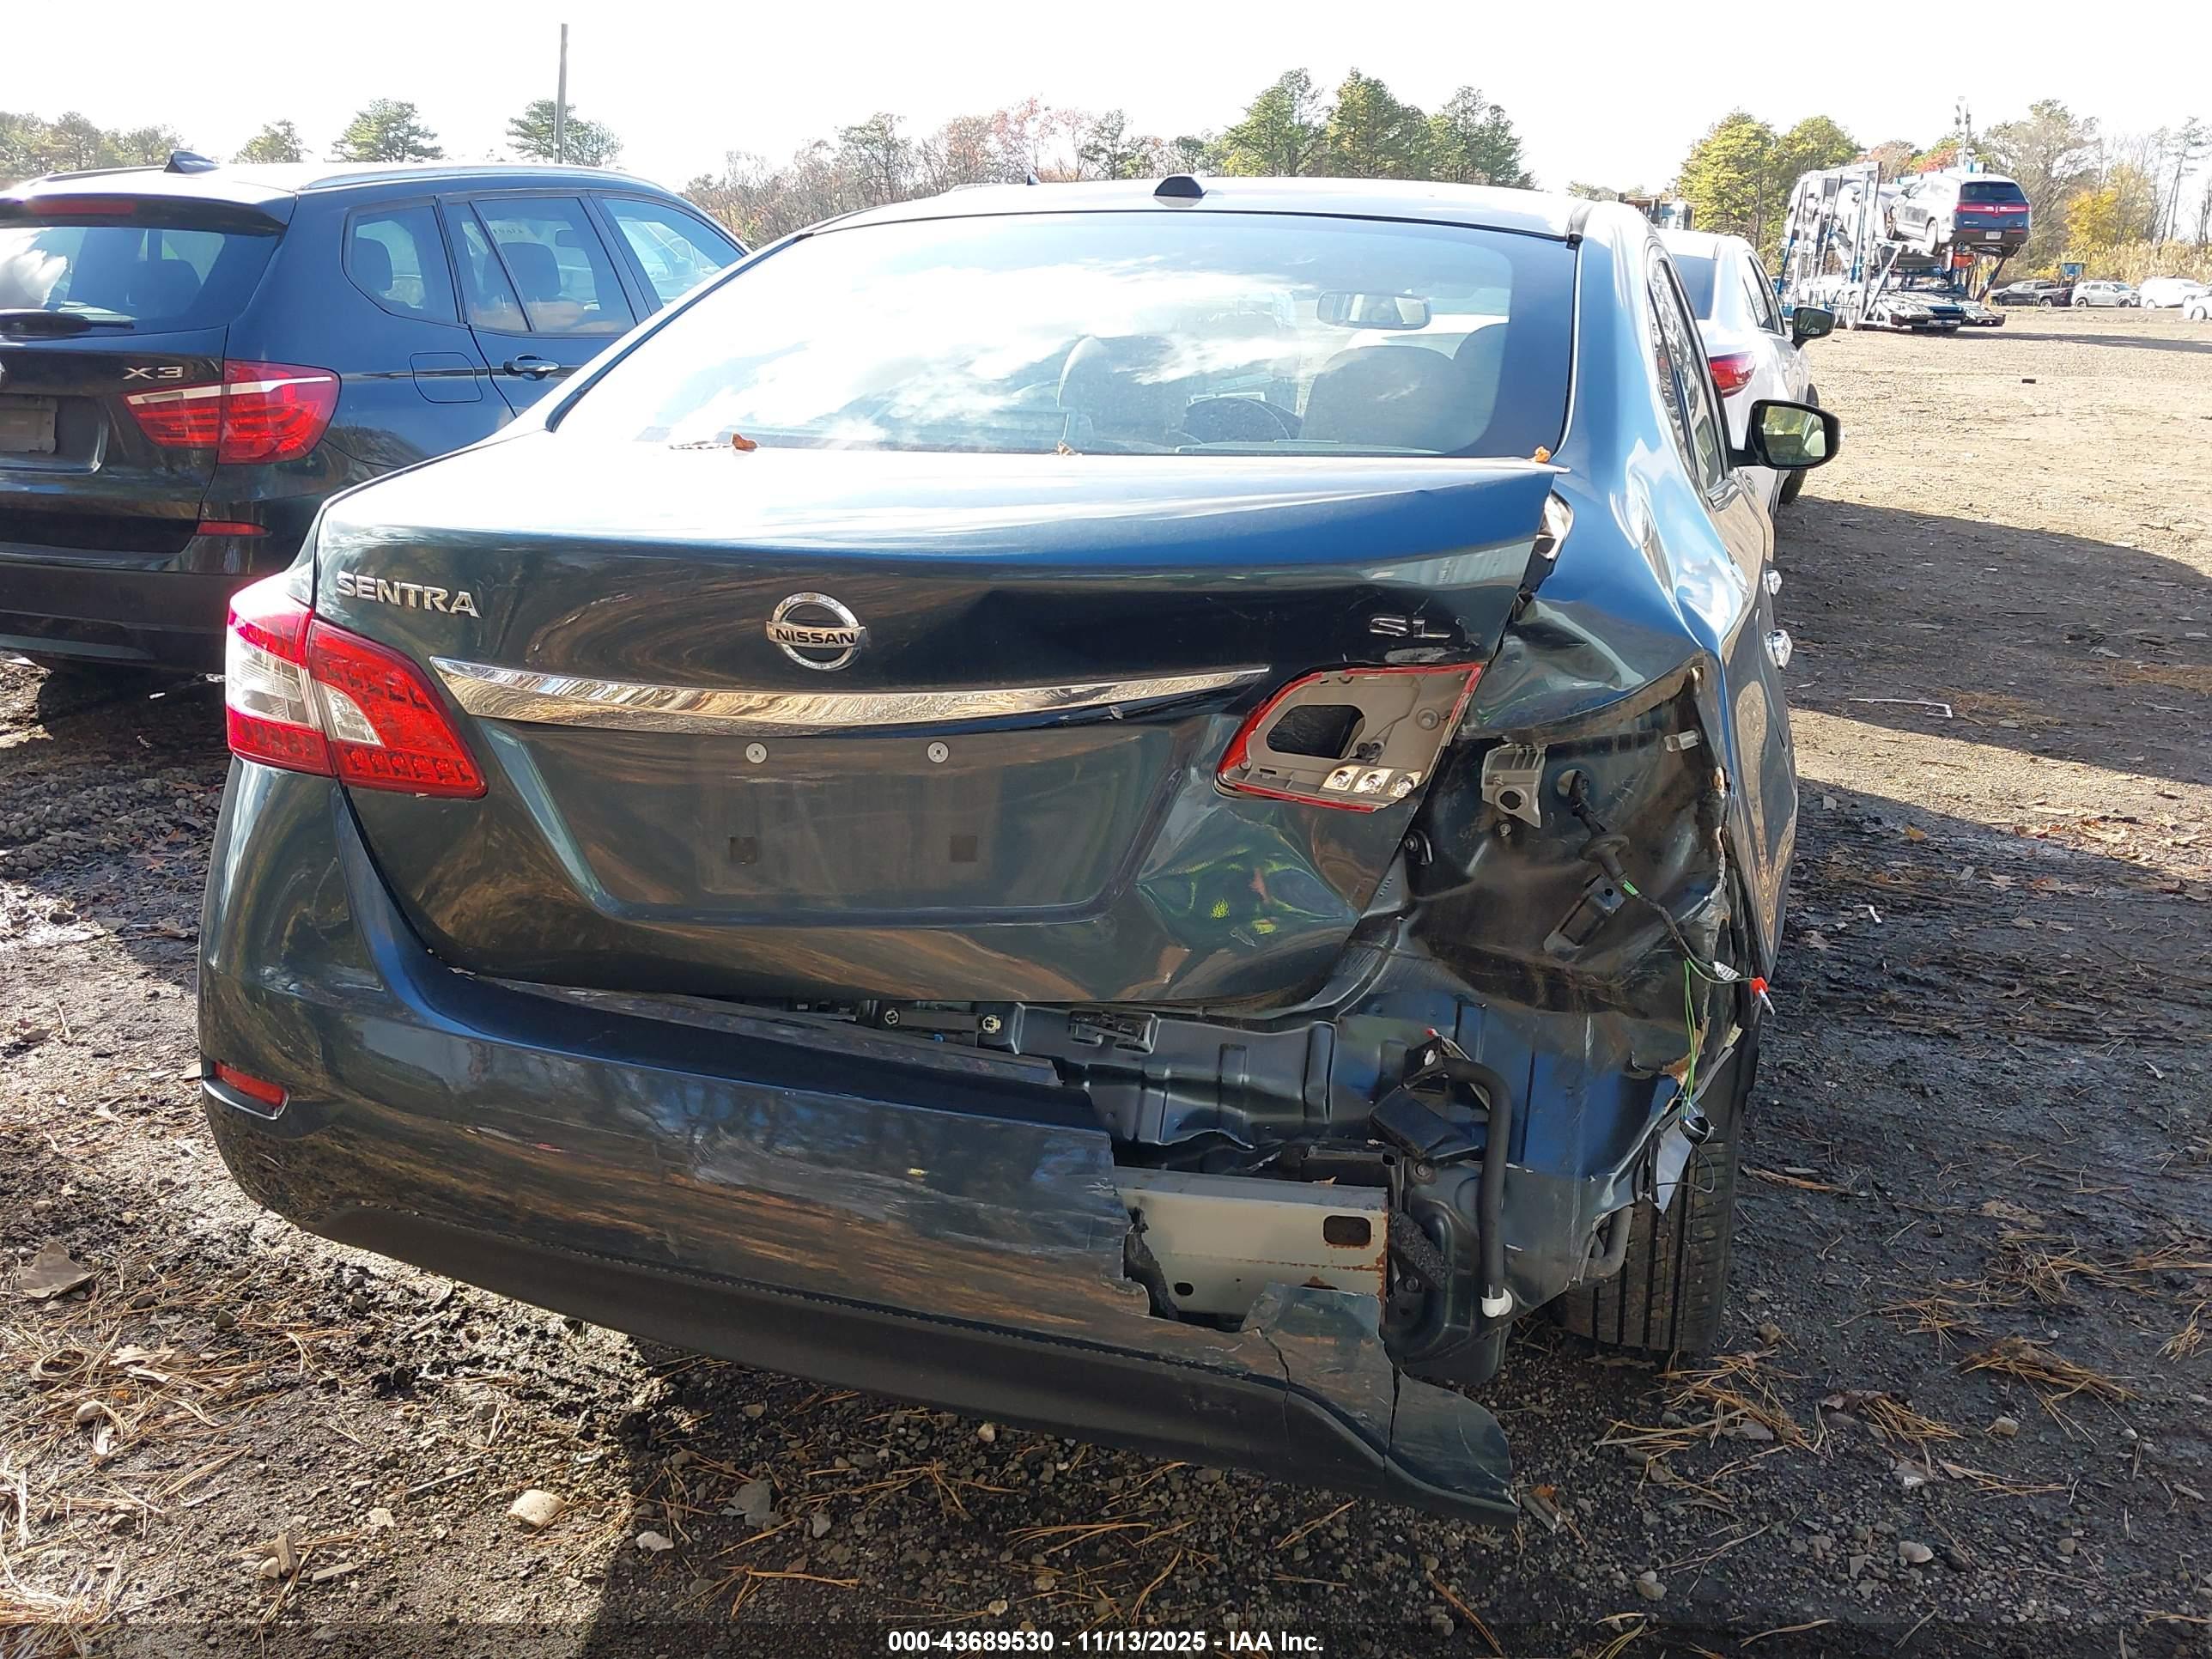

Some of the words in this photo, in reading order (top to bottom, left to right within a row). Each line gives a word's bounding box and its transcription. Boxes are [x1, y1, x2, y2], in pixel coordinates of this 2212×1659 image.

[122, 366, 183, 380] X3
[336, 570, 483, 618] SENTRA
[776, 628, 855, 645] NISSAN
[1369, 616, 1450, 638] SL
